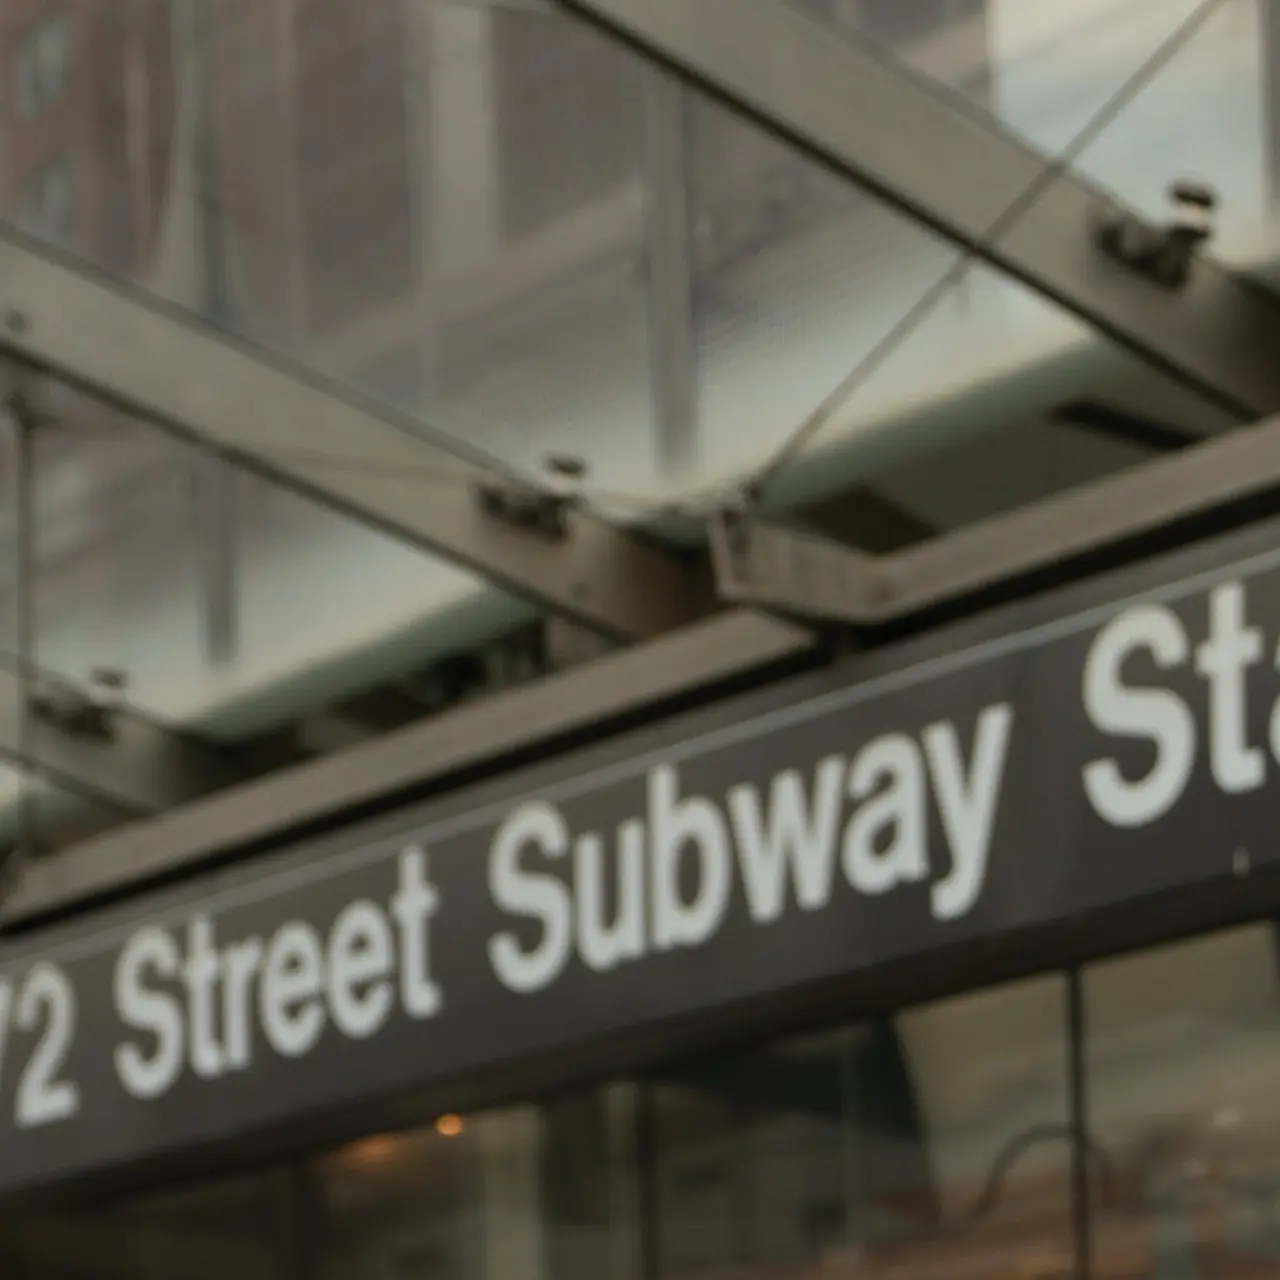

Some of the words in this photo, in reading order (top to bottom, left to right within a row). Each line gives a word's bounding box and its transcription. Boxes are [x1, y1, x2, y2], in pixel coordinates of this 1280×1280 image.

[0, 961, 79, 1127] 2
[114, 845, 441, 1097] Street
[488, 704, 1012, 992] Subway
